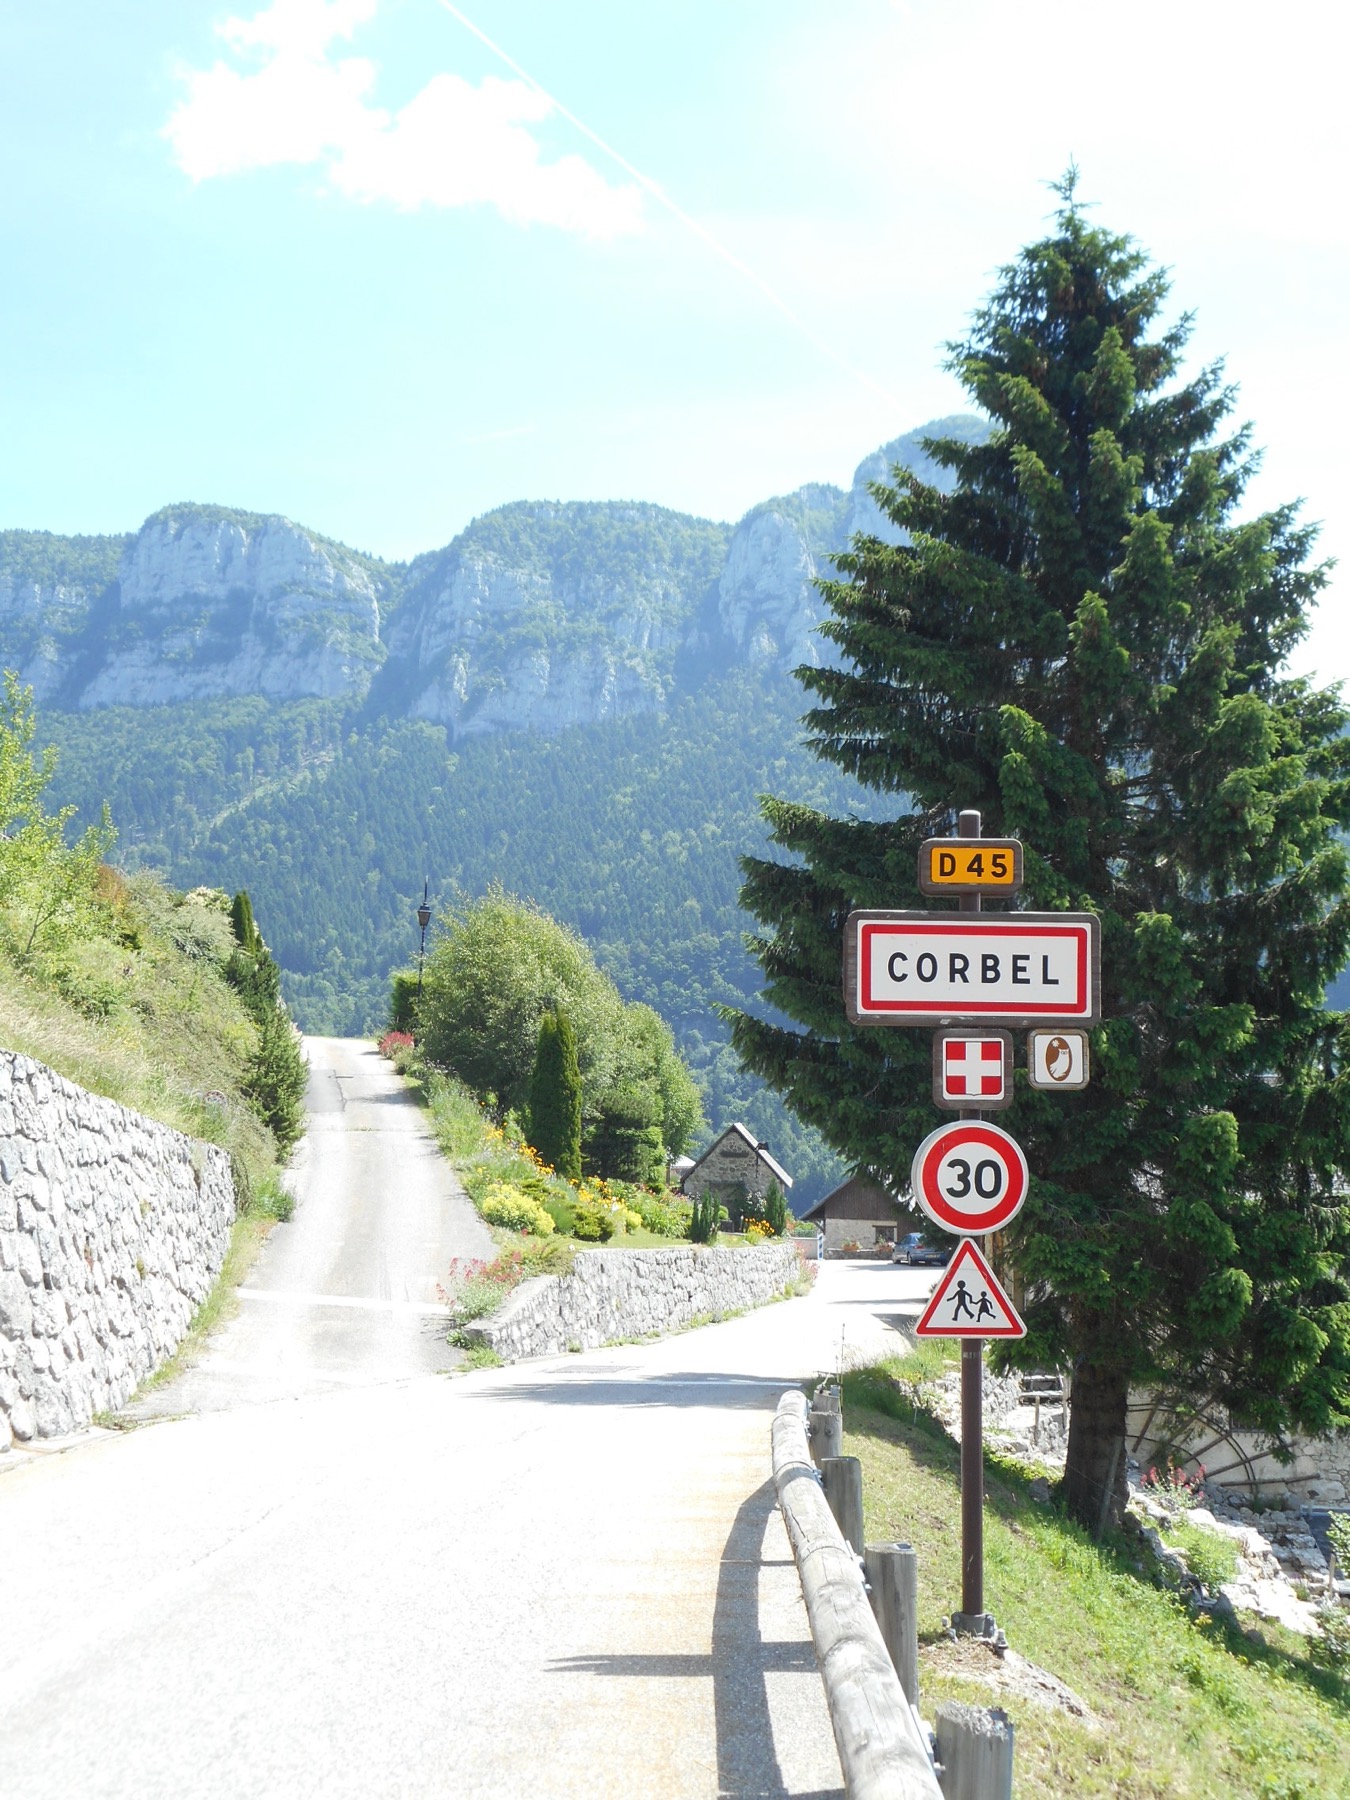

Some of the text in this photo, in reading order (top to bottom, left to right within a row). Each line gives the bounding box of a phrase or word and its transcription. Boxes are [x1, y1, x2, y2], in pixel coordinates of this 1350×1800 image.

[939, 853, 1008, 878] D 45
[888, 951, 1060, 985] CORBEL
[945, 1158, 1002, 1200] 30
